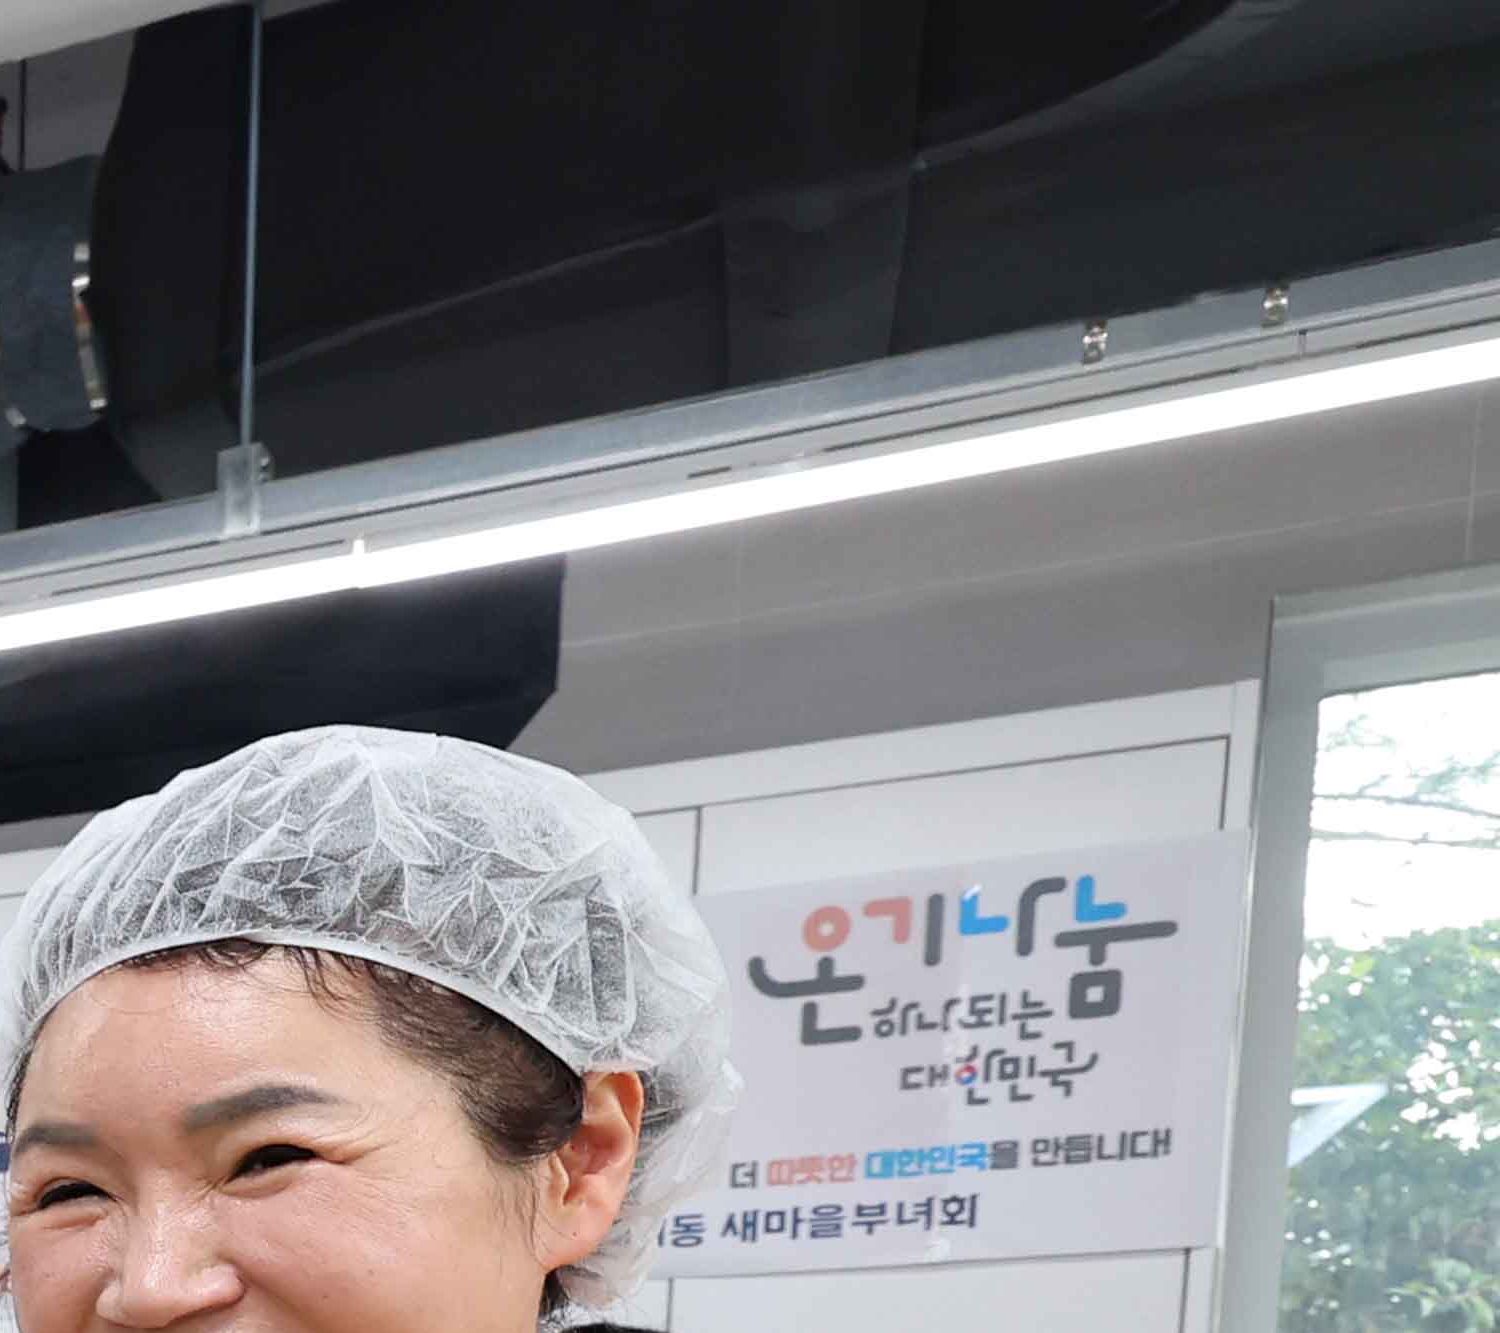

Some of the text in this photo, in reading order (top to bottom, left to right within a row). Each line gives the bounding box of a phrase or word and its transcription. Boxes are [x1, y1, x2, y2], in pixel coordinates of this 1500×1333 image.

[748, 874, 1178, 1046] 온기나눔
[870, 990, 1054, 1041] 하나되는
[900, 1040, 1099, 1105] 대한민국
[729, 1160, 758, 1190] 더
[766, 1153, 857, 1189] 따뜻한
[721, 1192, 980, 1245] 새마을부녀회
